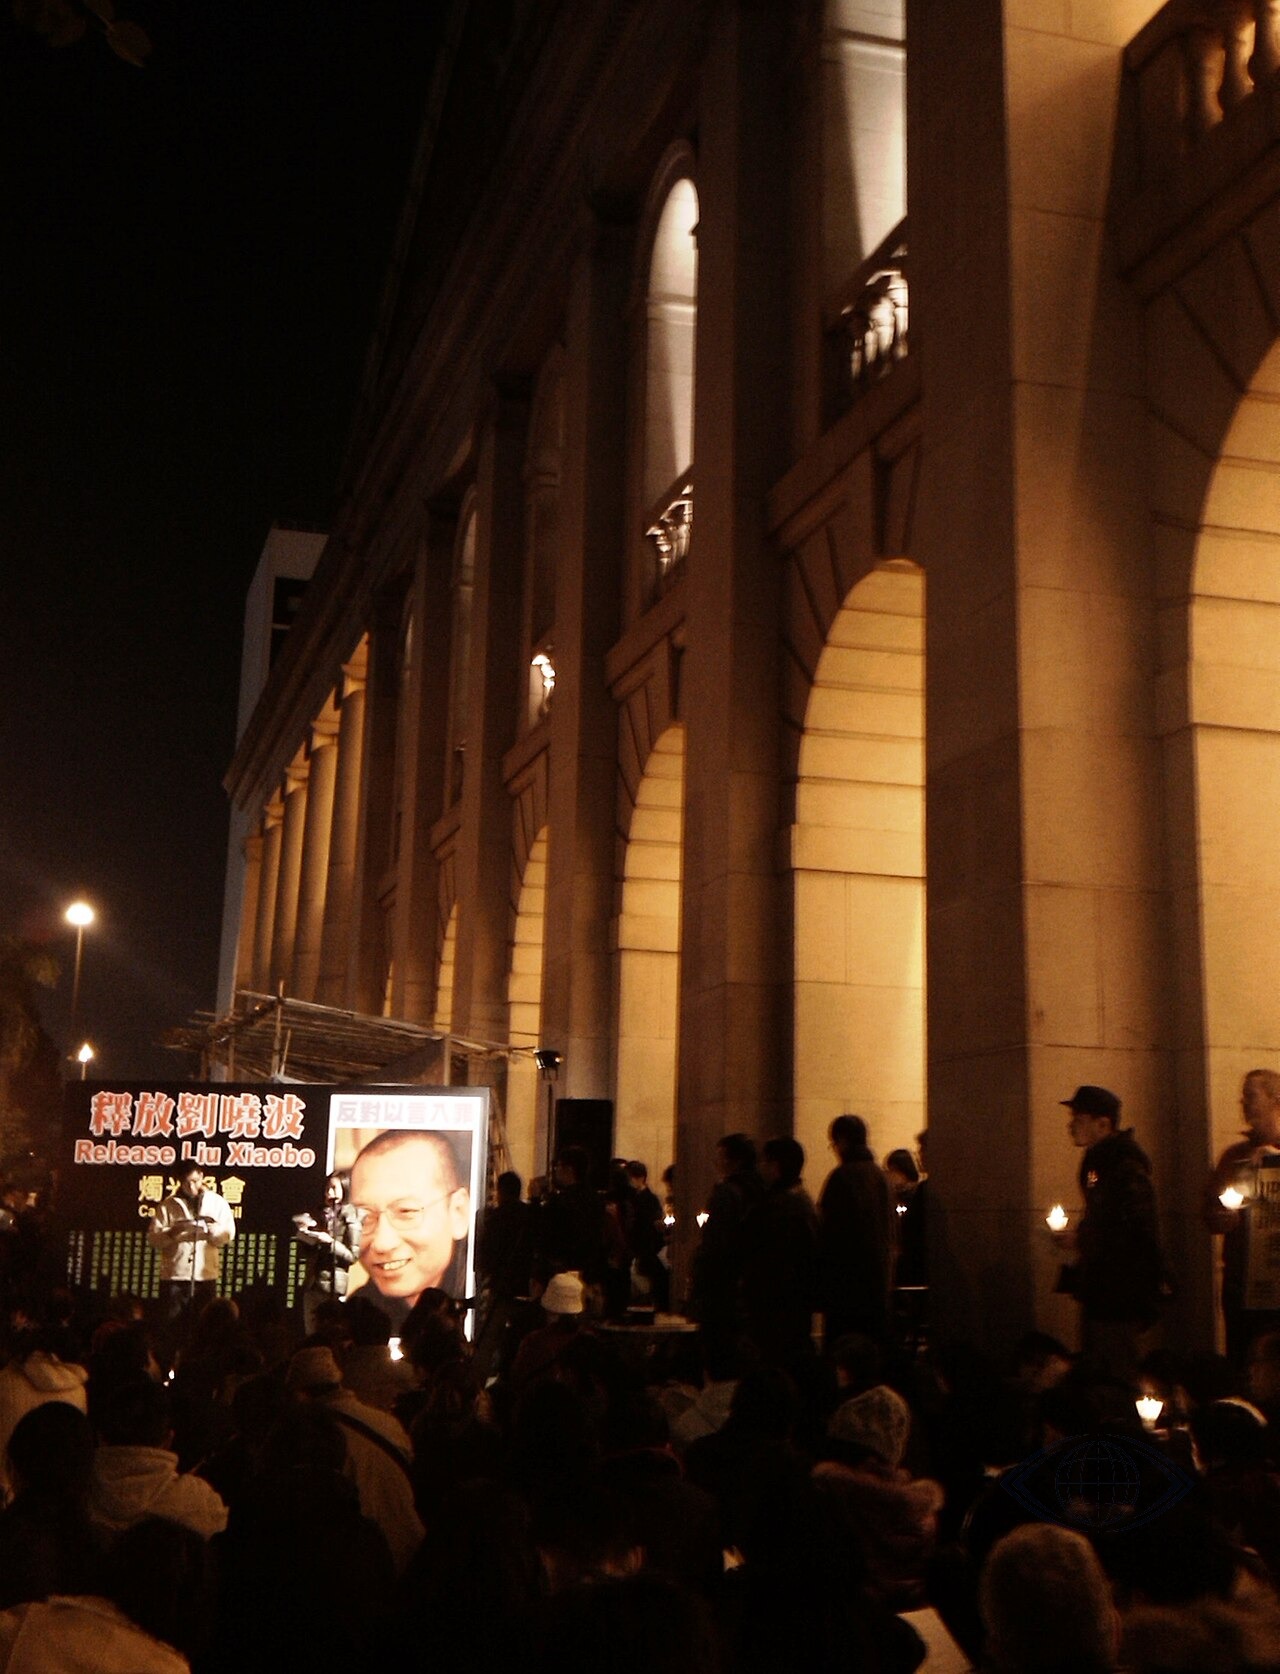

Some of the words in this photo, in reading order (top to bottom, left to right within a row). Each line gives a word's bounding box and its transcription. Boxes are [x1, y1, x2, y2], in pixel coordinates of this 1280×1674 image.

[89, 1091, 306, 1139] 釋放劉曉波
[74, 1139, 176, 1165] Release
[181, 1140, 221, 1166] Liu
[225, 1141, 316, 1168] Xiaobo
